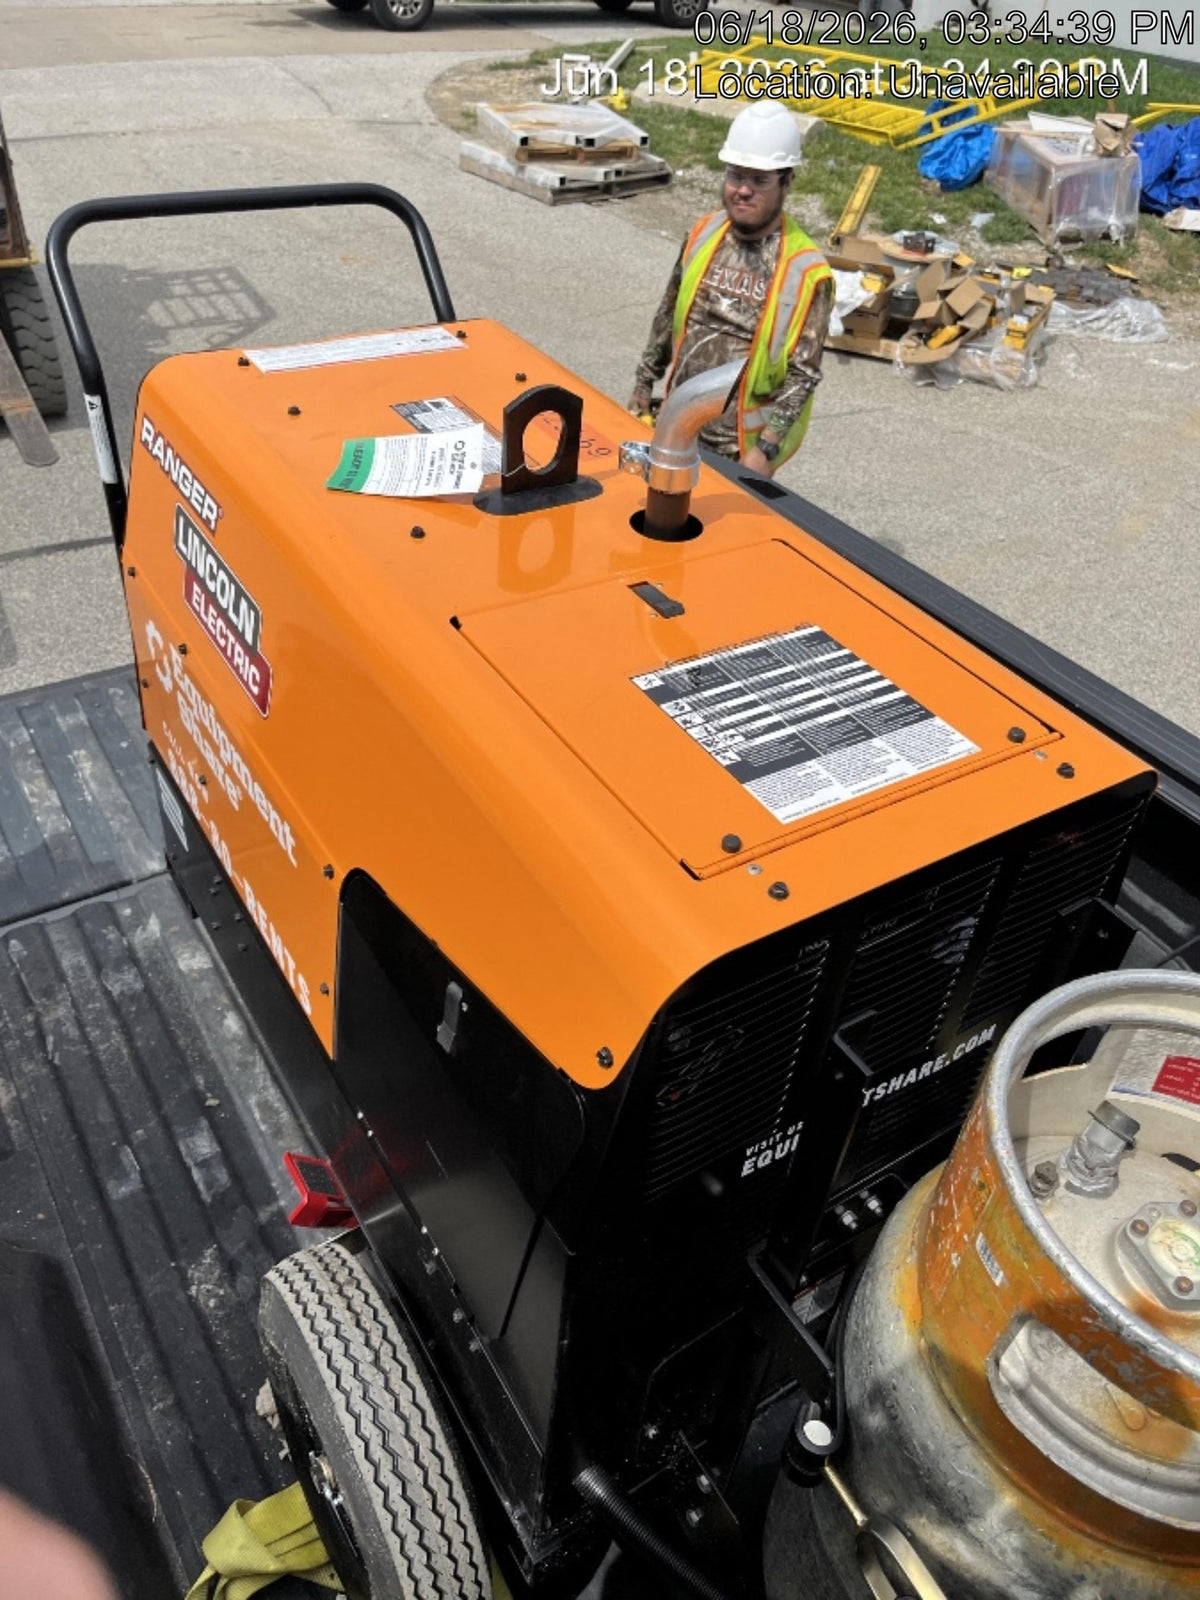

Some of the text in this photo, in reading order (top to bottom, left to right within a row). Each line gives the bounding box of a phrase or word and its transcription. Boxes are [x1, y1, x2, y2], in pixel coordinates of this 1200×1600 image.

[703, 264, 768, 301] EXAS
[141, 417, 218, 530] RANGER
[177, 514, 256, 647] LINCOLN
[191, 580, 261, 696] ELECTRIC
[169, 642, 298, 868] Equipment
[745, 1121, 804, 1157] VISIT US
